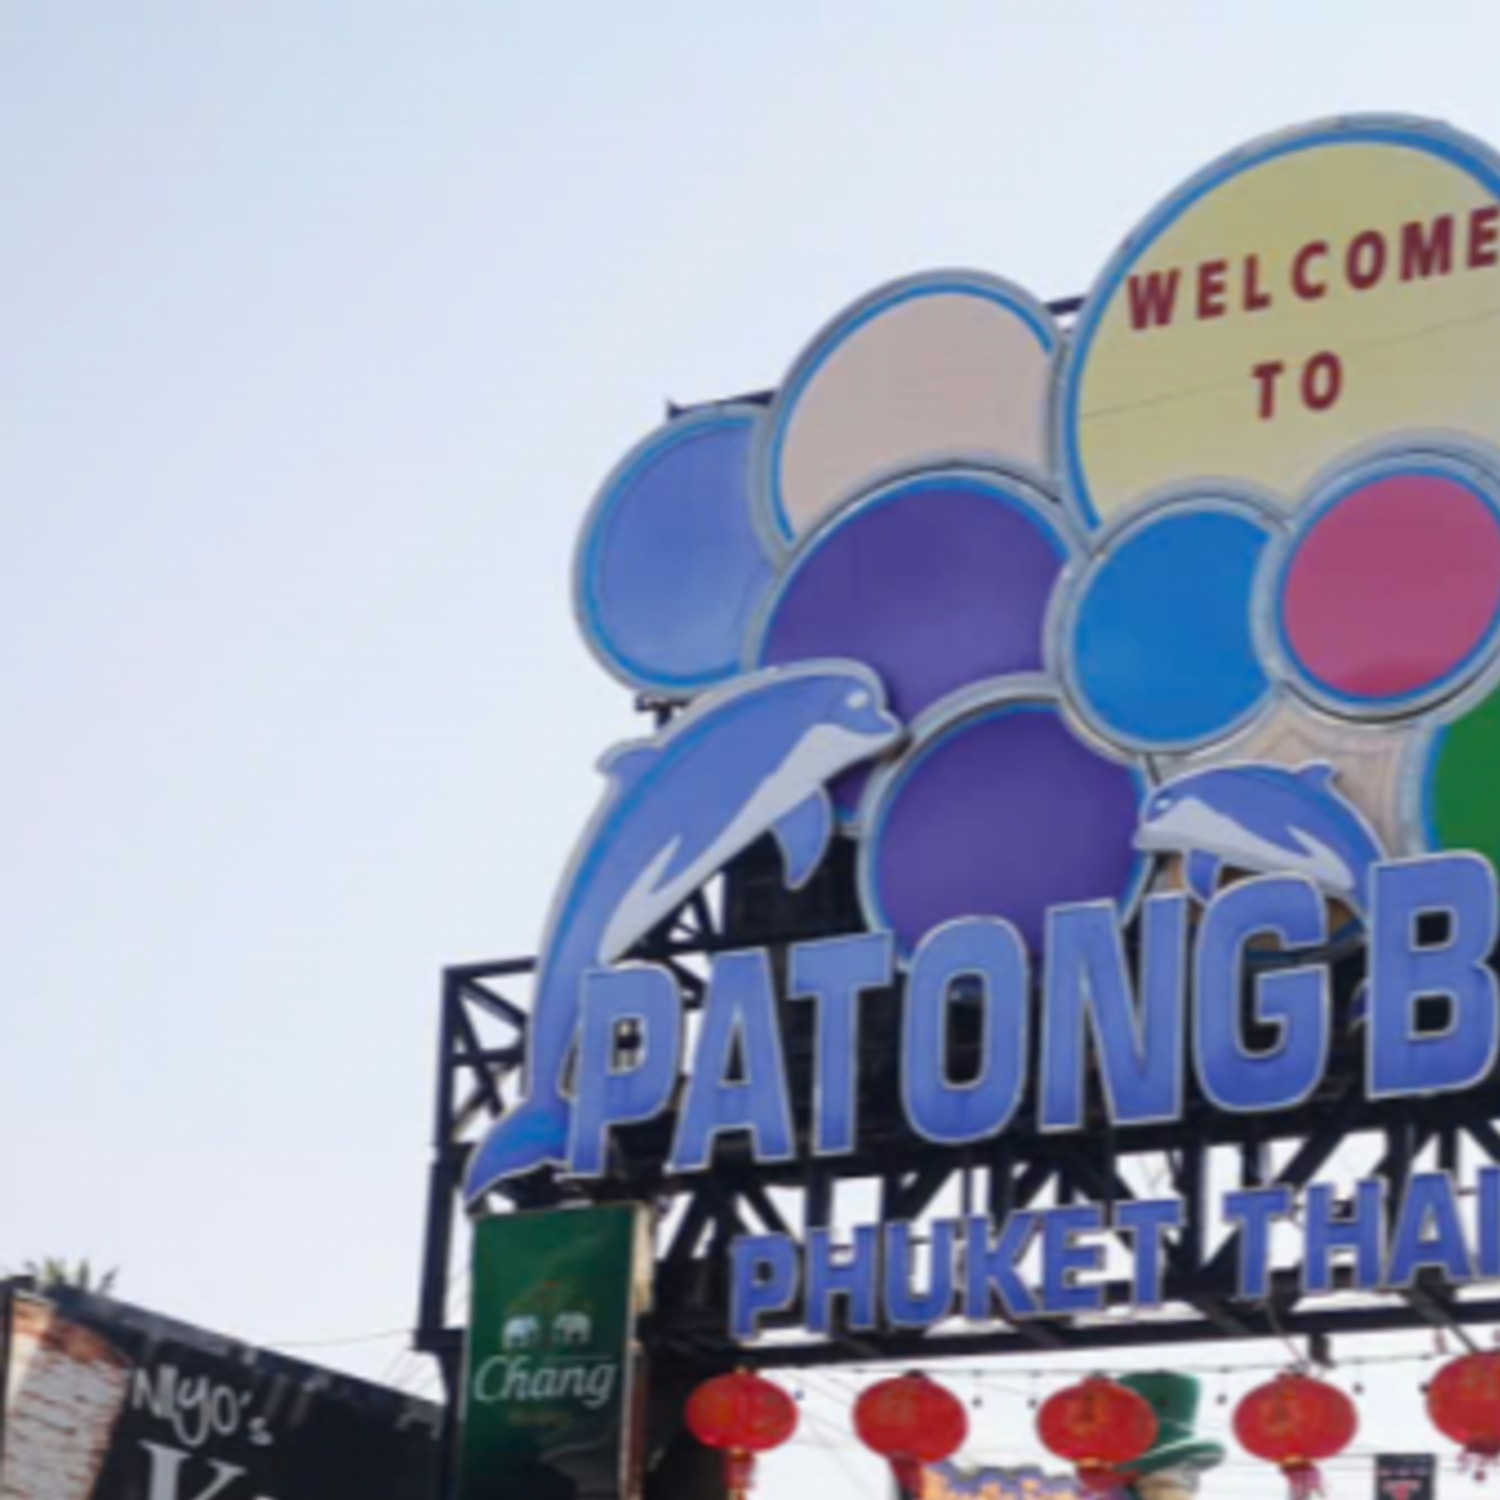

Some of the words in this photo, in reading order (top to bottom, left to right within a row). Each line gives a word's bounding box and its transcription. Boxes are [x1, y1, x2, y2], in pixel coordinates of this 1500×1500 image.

[1127, 206, 1500, 331] WELCOME
[1251, 350, 1343, 421] TO
[564, 872, 1329, 1181] PATONG
[729, 1199, 1186, 1341] PHUKET
[474, 1354, 617, 1409] Chang
